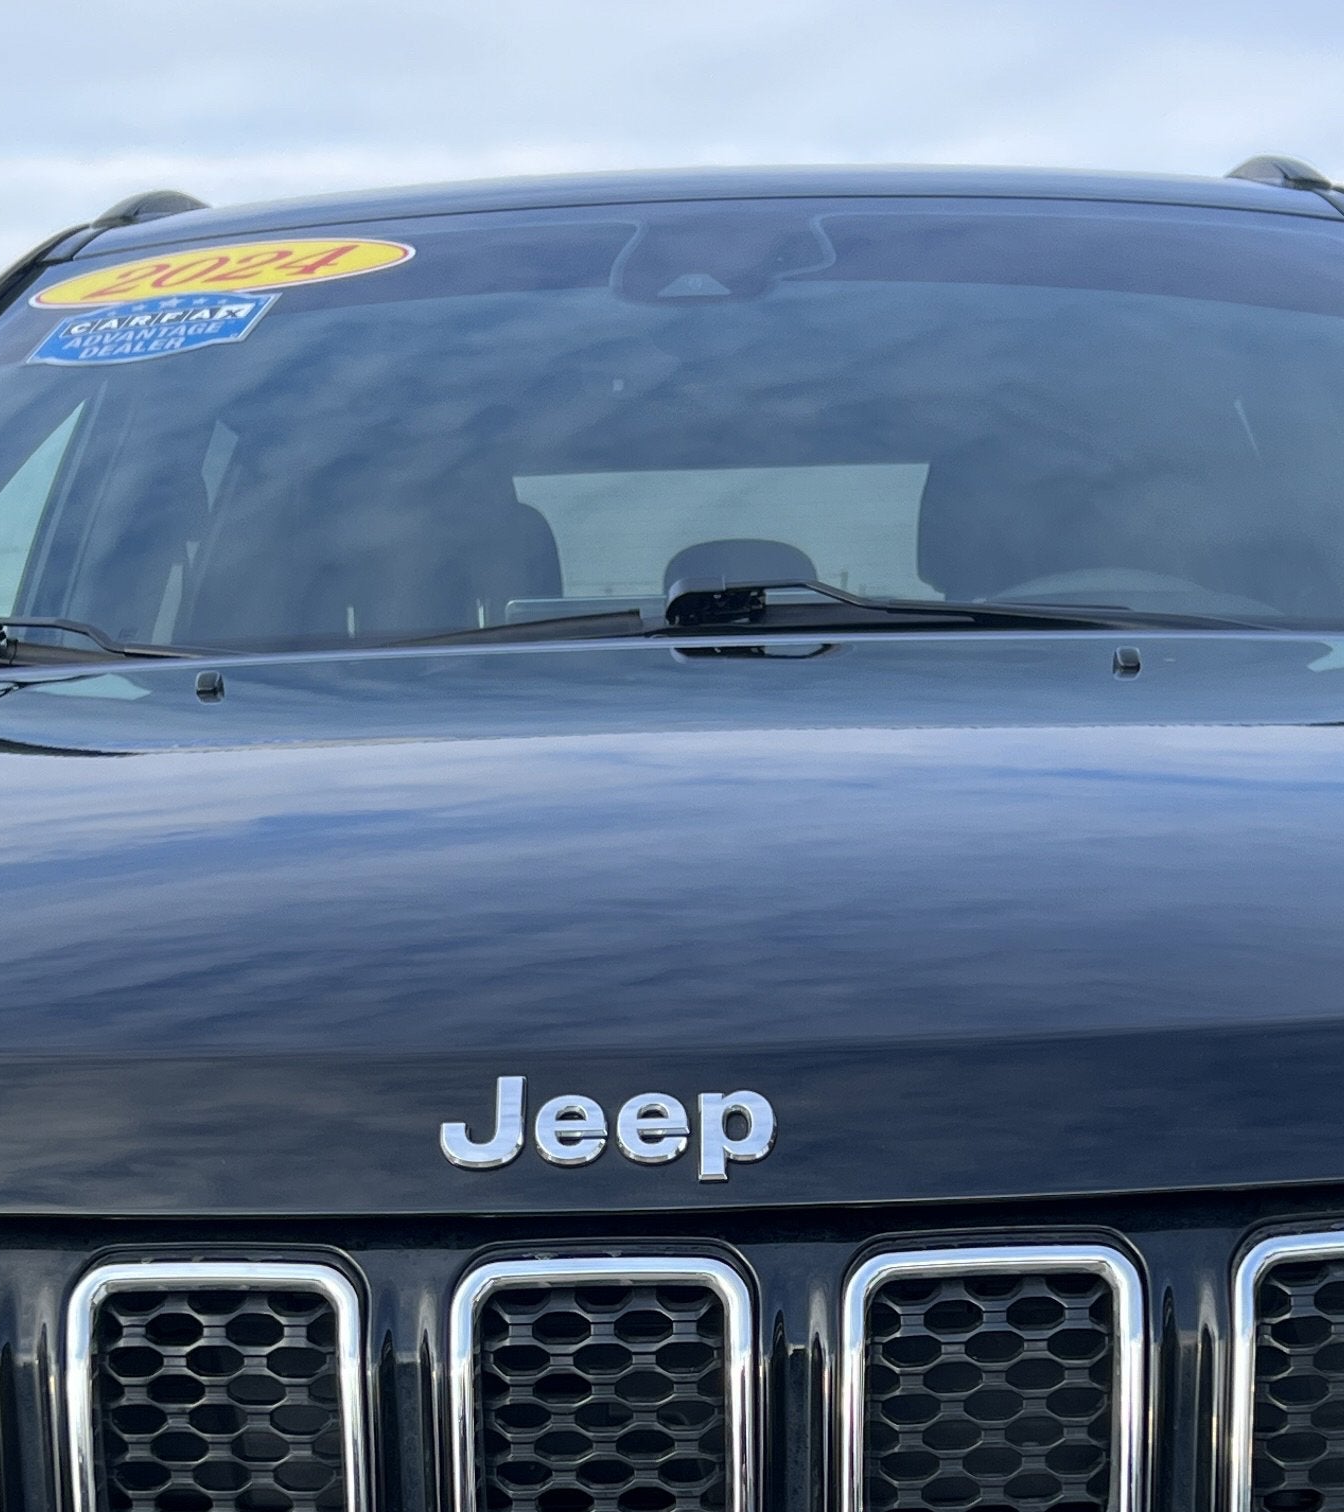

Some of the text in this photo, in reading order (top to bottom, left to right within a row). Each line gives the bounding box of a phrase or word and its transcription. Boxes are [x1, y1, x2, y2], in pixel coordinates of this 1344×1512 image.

[80, 244, 360, 300] 2024
[62, 321, 222, 350] ADVANTAGE
[66, 304, 255, 336] CARFAX
[78, 337, 186, 360] DEALER
[440, 1075, 778, 1182] Jeep
